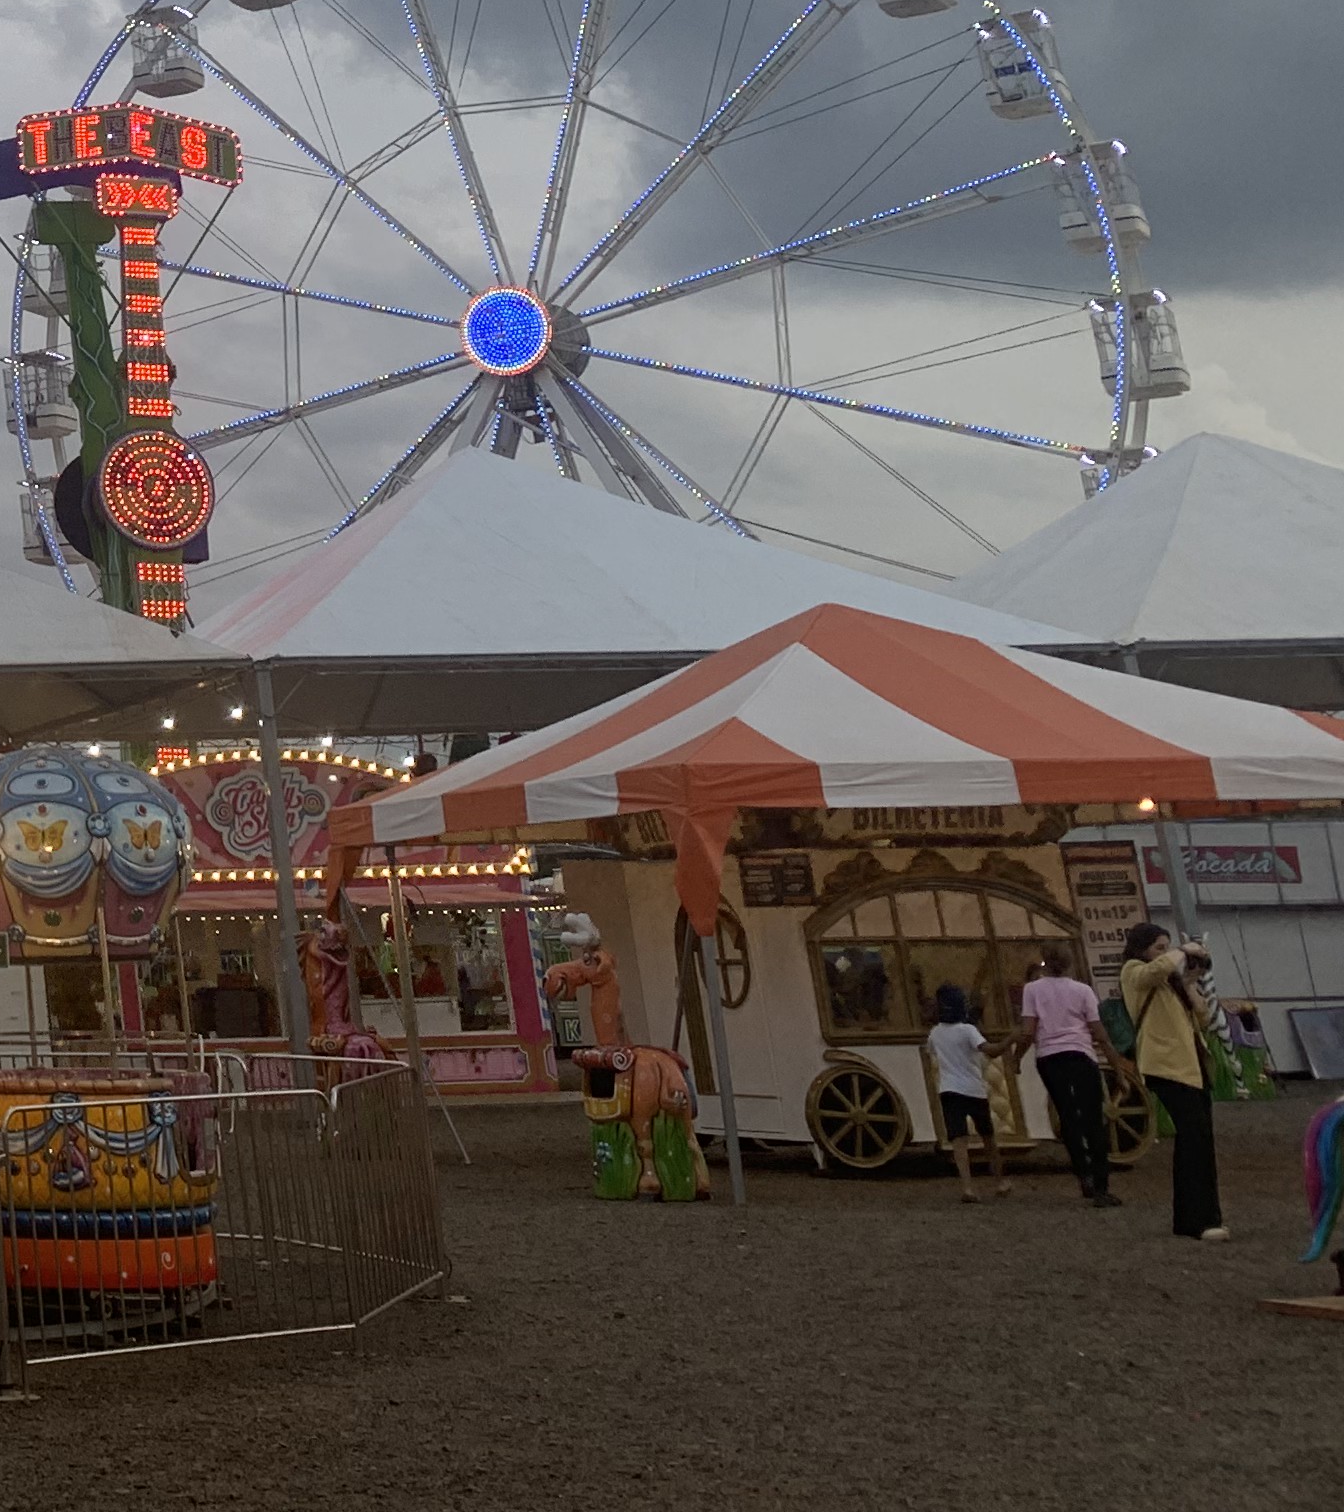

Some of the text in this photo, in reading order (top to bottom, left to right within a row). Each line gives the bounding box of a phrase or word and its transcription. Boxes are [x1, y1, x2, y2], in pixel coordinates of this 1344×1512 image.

[26, 111, 230, 176] THE BEAST
[224, 780, 302, 813] Cay
